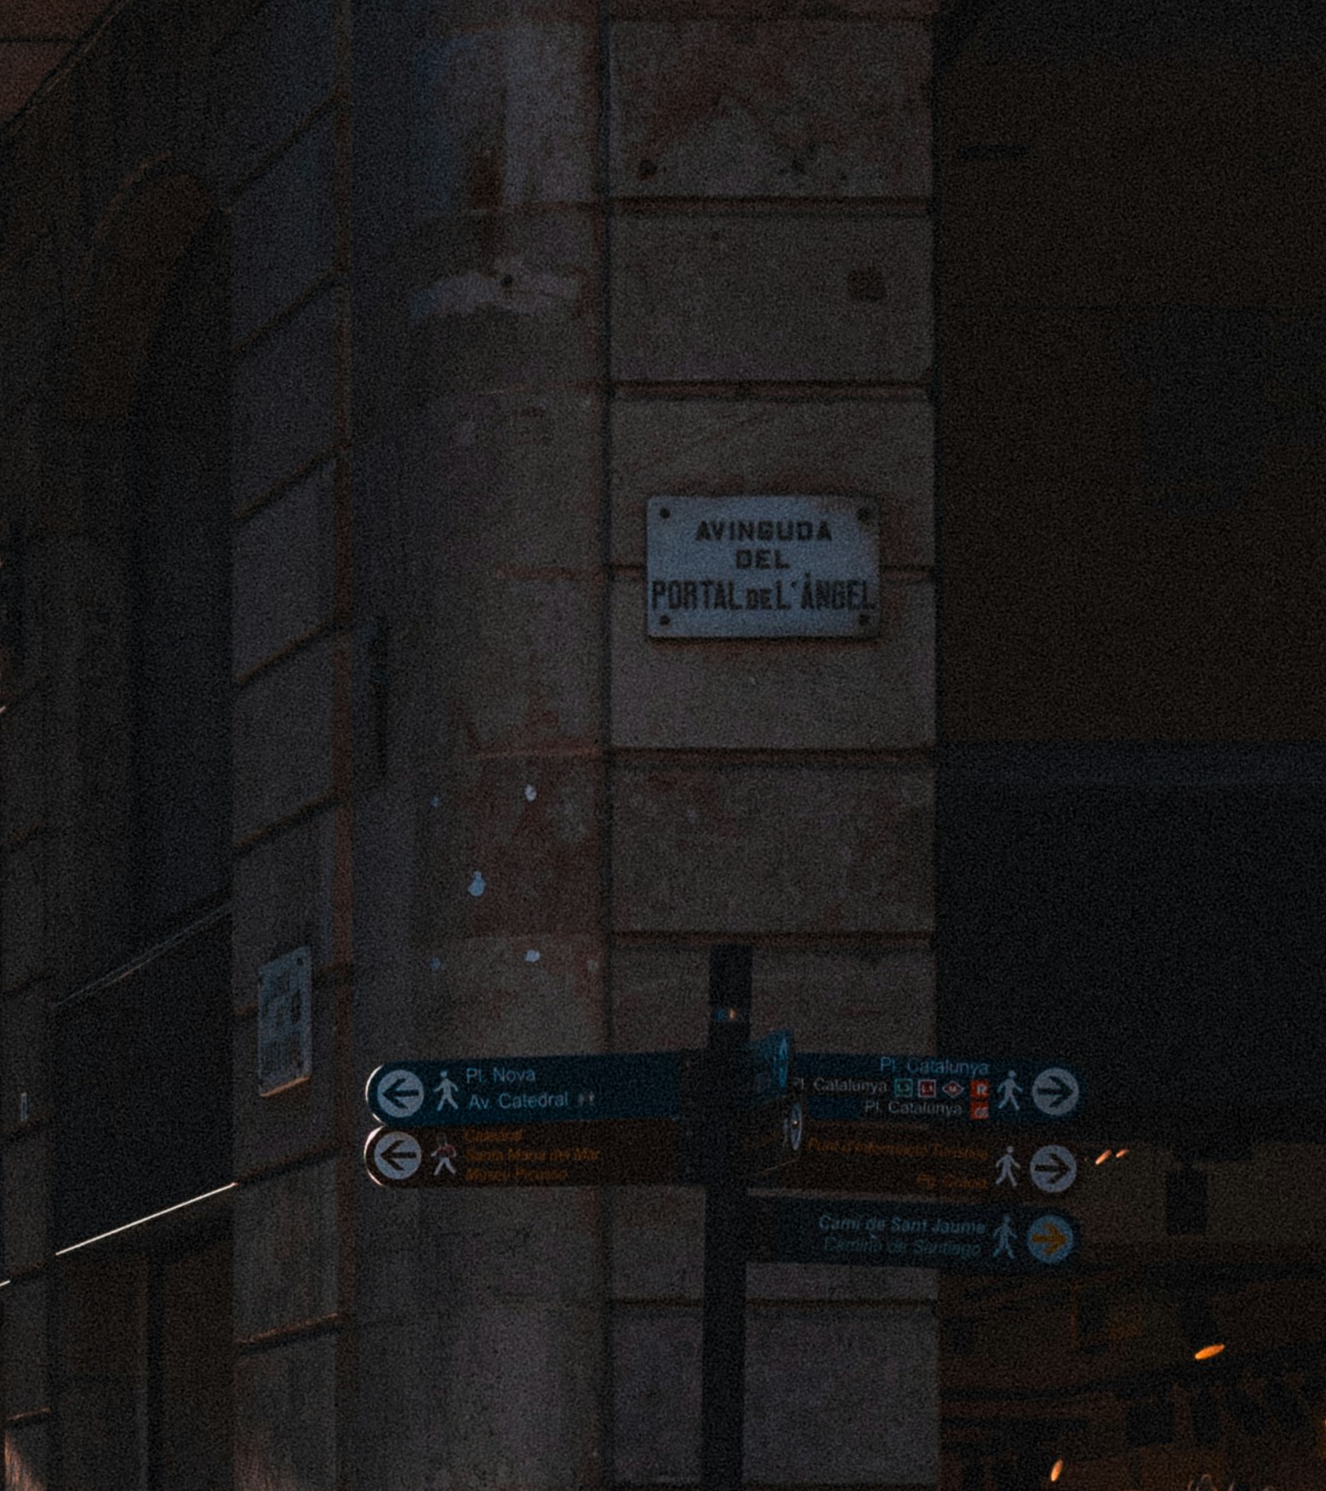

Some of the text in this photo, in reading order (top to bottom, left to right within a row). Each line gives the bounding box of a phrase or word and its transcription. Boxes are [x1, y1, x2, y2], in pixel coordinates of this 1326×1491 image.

[695, 520, 833, 542] AVINGUDA
[735, 549, 790, 570] DEL
[652, 580, 743, 609] PORTAL
[493, 1066, 537, 1083] Nova
[906, 1058, 990, 1078] Catalunya
[813, 1076, 888, 1094] Catalunya
[499, 1091, 570, 1108] Catedral
[888, 1100, 963, 1117] Catalunya
[865, 1216, 887, 1232] de
[890, 1215, 928, 1233] Sant
[931, 1217, 986, 1235] Jaume
